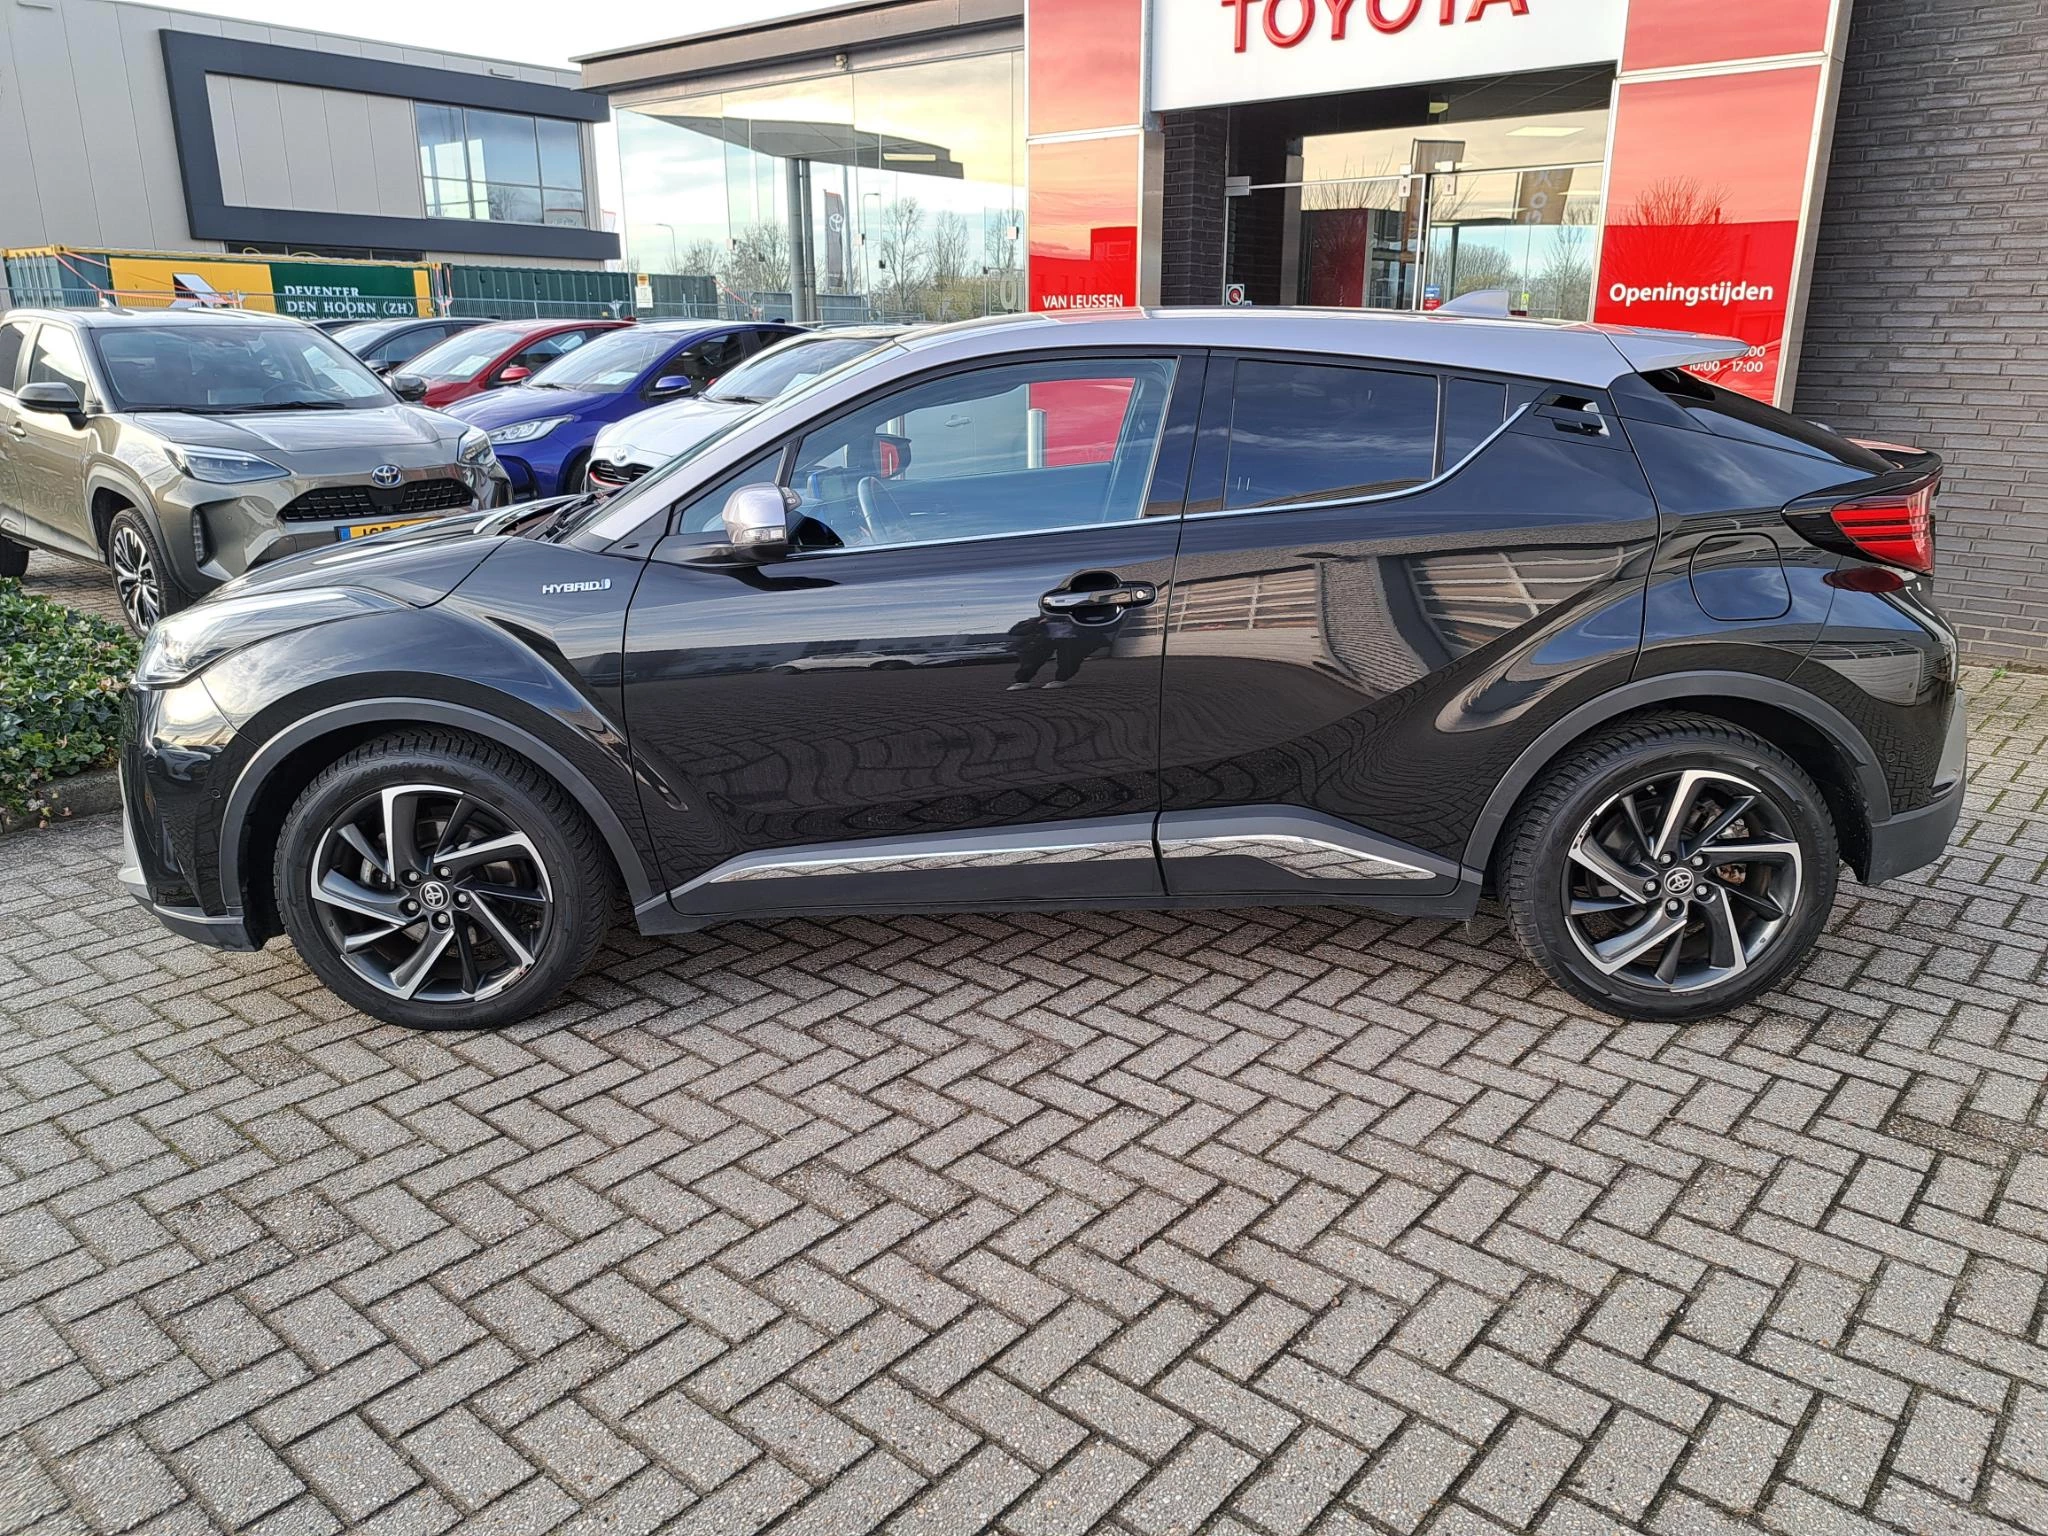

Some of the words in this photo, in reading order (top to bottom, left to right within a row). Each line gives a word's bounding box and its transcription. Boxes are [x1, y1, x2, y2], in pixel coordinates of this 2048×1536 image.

[284, 285, 360, 297] DEVENTER
[1609, 281, 1773, 307] Openingstijden
[1042, 294, 1067, 308] VAN
[1070, 293, 1123, 308] LEUSSEN
[286, 301, 317, 312] DEN
[324, 301, 376, 313] HOORN
[383, 301, 414, 315] (ZH)
[1732, 360, 1763, 372] 17:00
[542, 580, 601, 595] HYBRID
